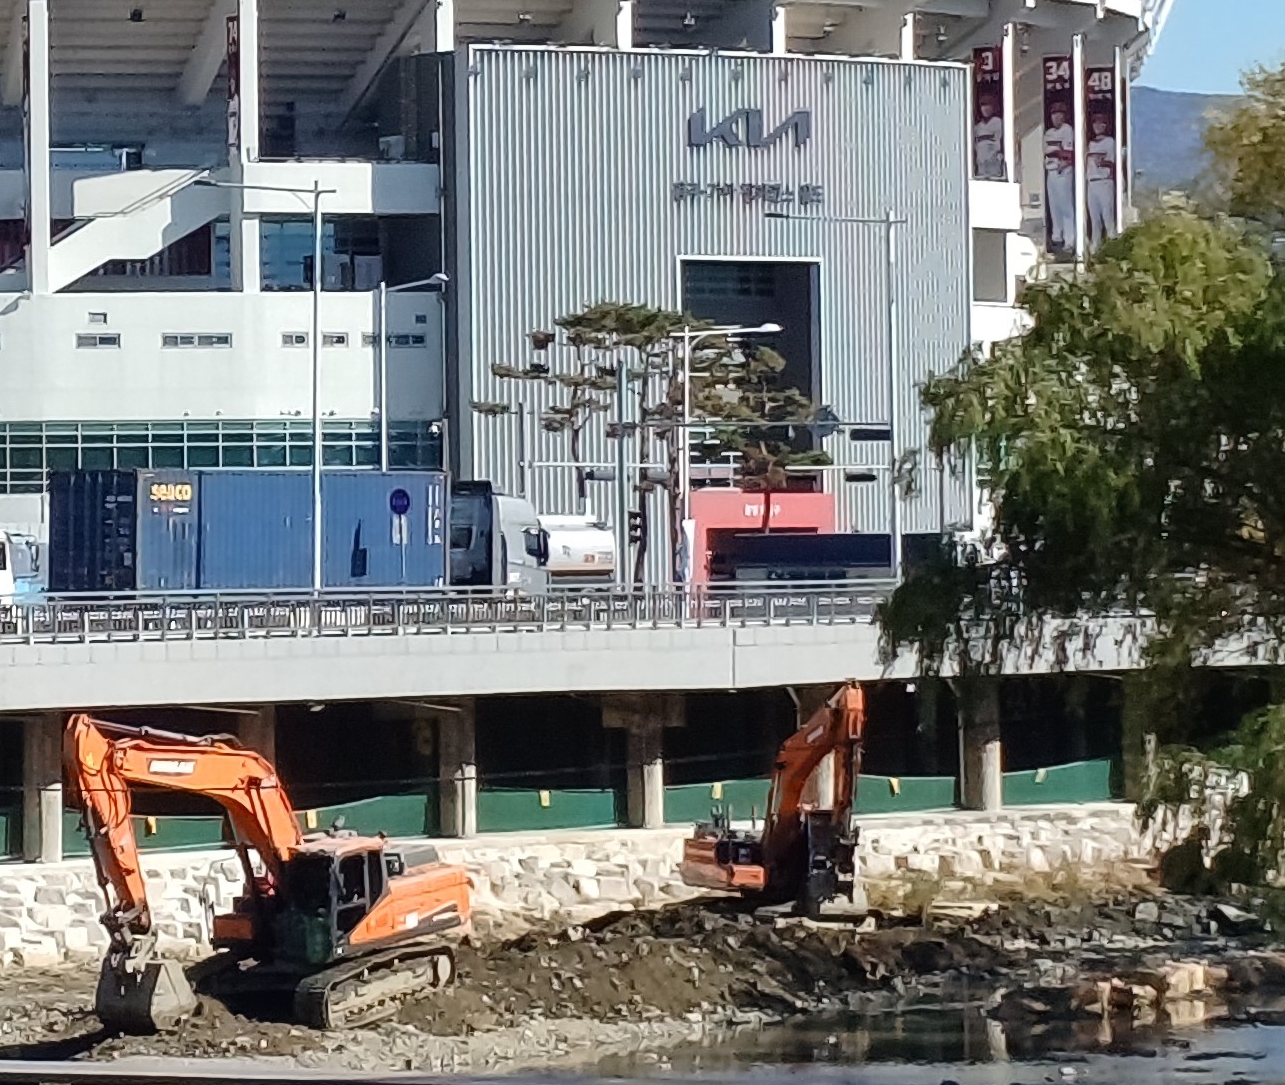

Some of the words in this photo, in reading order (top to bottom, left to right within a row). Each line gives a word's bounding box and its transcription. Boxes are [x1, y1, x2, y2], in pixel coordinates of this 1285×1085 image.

[1046, 61, 1069, 80] 34
[1088, 72, 1111, 90] 48
[688, 107, 811, 147] KIA
